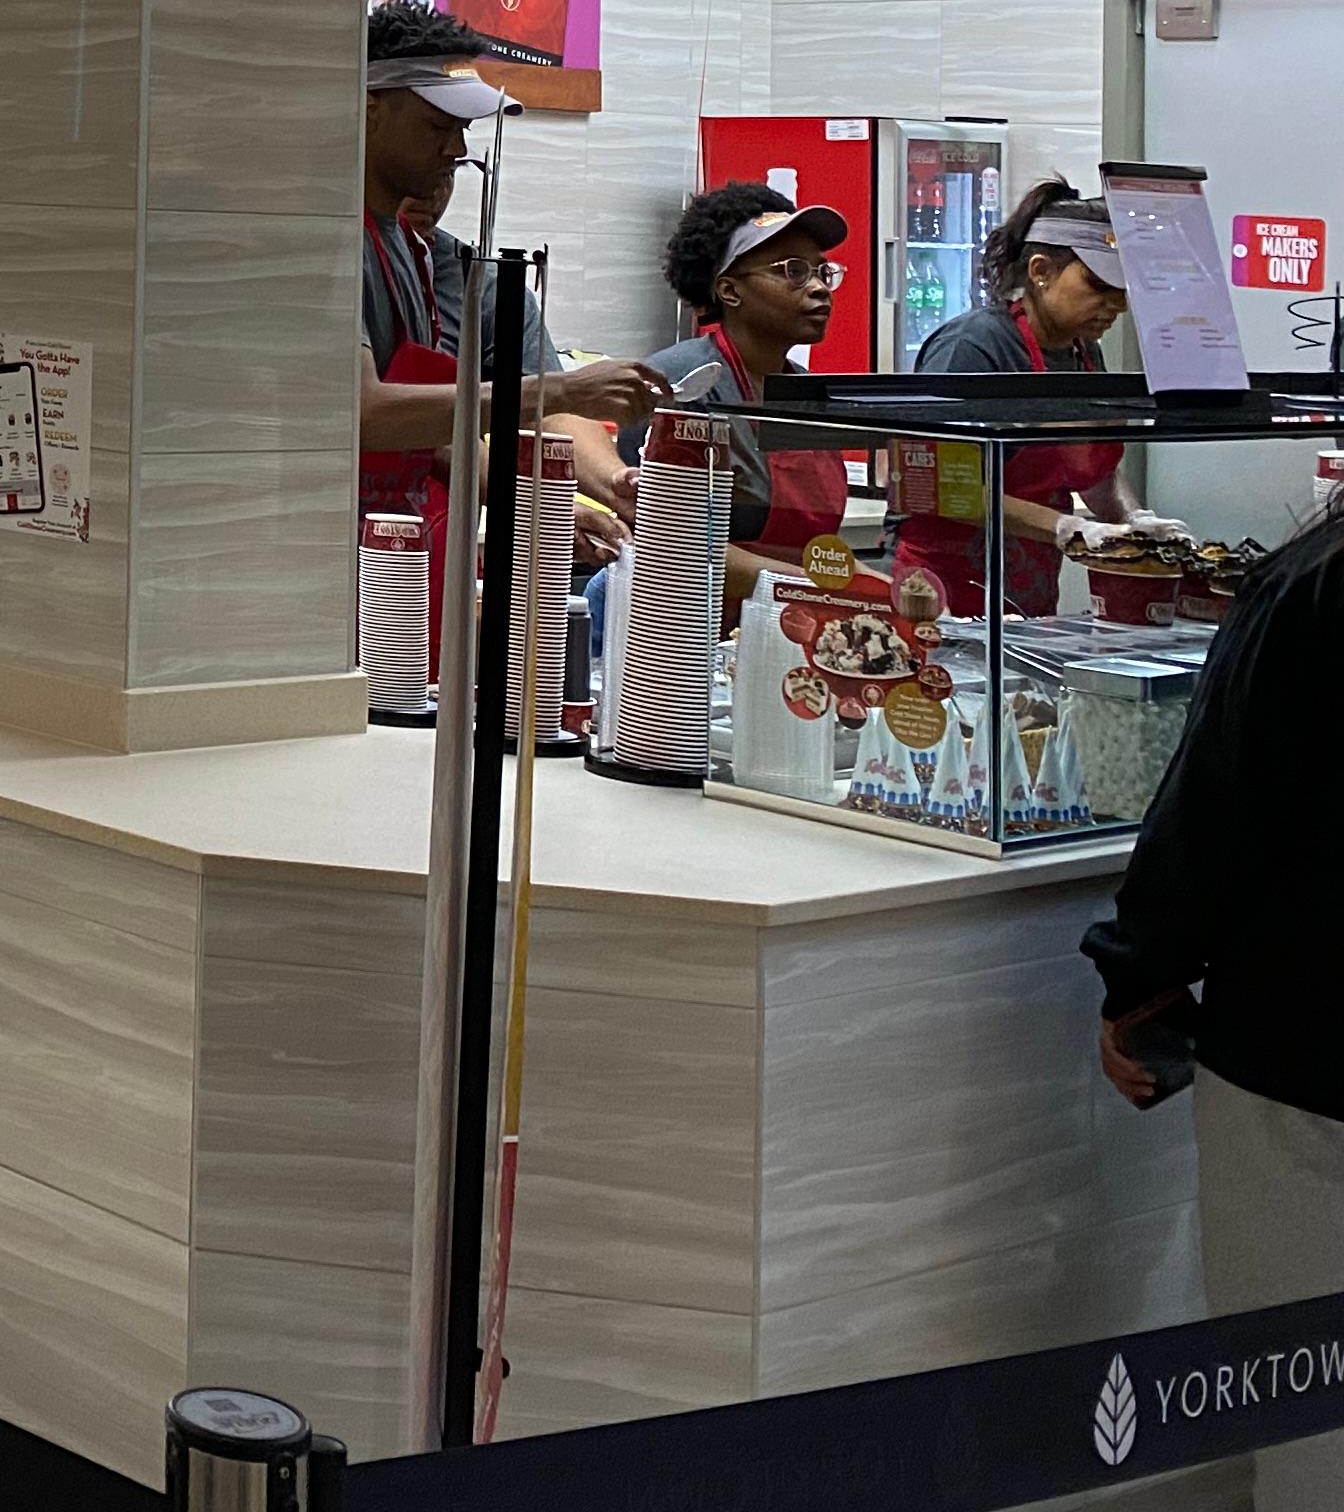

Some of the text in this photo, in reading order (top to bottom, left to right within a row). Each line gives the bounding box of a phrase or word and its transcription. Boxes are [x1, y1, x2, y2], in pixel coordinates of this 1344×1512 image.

[491, 43, 552, 67] ONE CREAMERY
[1271, 224, 1299, 237] CREAM
[1261, 236, 1319, 259] MAKERS
[1269, 257, 1312, 285] ONLY
[19, 349, 80, 365] You Gotta Have
[37, 362, 71, 378] the App!
[43, 408, 64, 419] EARN
[45, 430, 78, 443] REDEEM
[905, 451, 936, 468] CAKES
[811, 545, 848, 563] Order
[808, 560, 850, 578] Ahead
[775, 587, 892, 613] ColdStoneCreamery.com
[1155, 1340, 1344, 1425] YORKTOW
